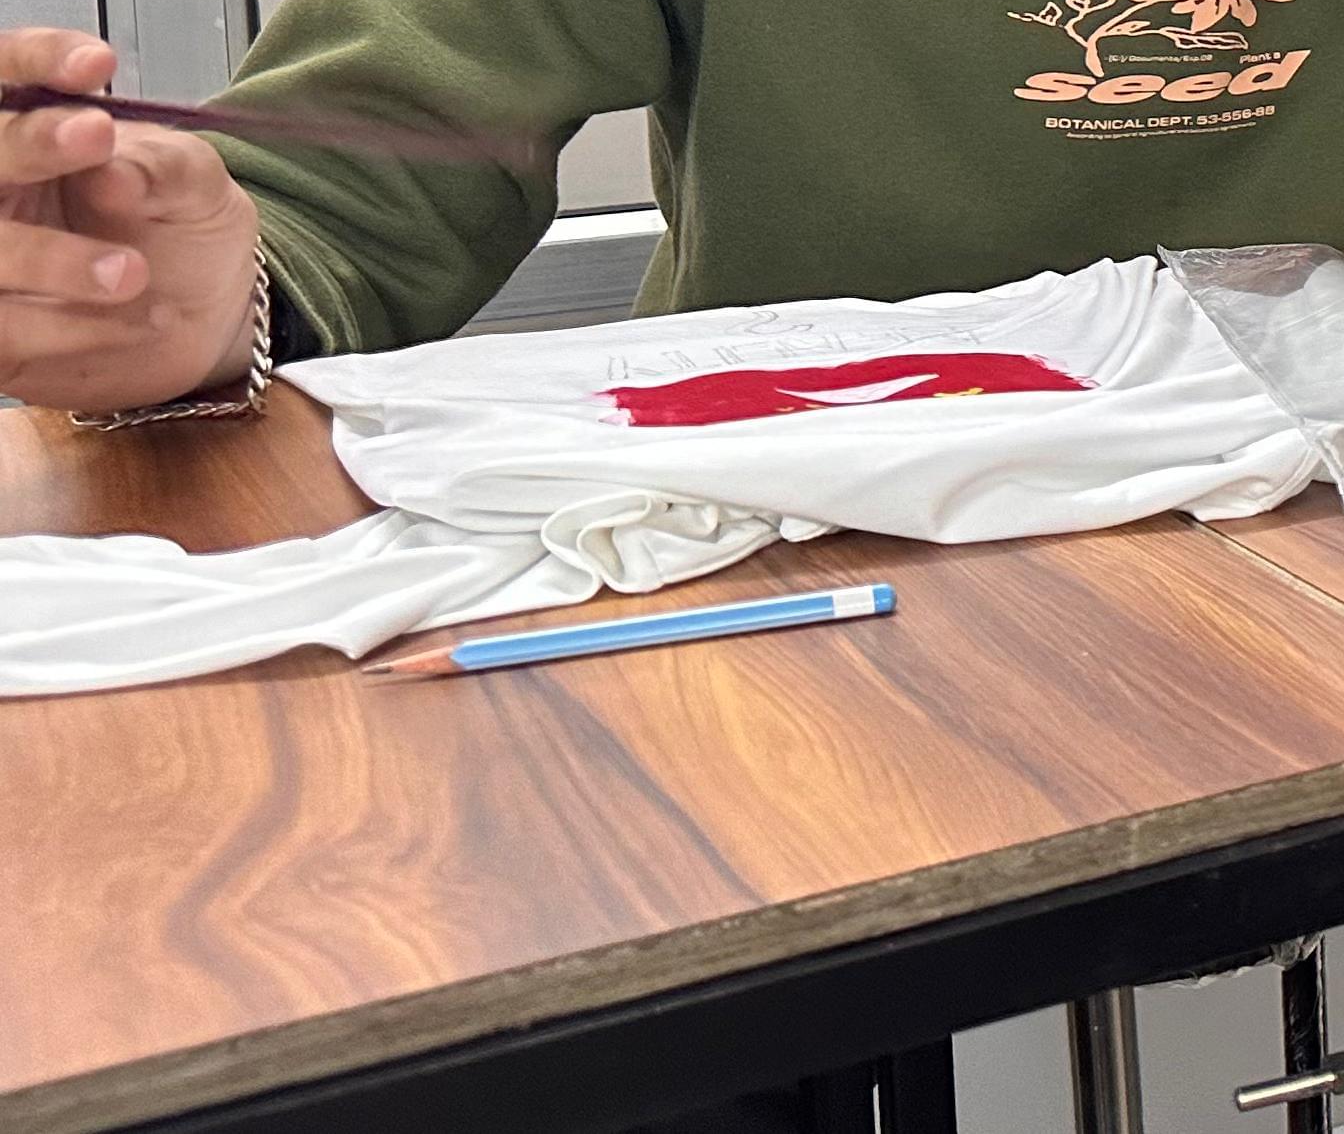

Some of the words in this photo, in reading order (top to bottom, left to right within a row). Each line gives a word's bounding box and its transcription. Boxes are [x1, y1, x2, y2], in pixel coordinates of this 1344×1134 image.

[1239, 53, 1270, 64] Plant
[1013, 49, 1312, 104] seed
[1045, 117, 1144, 130] BOTANICAL
[1147, 116, 1194, 127] DEPT.
